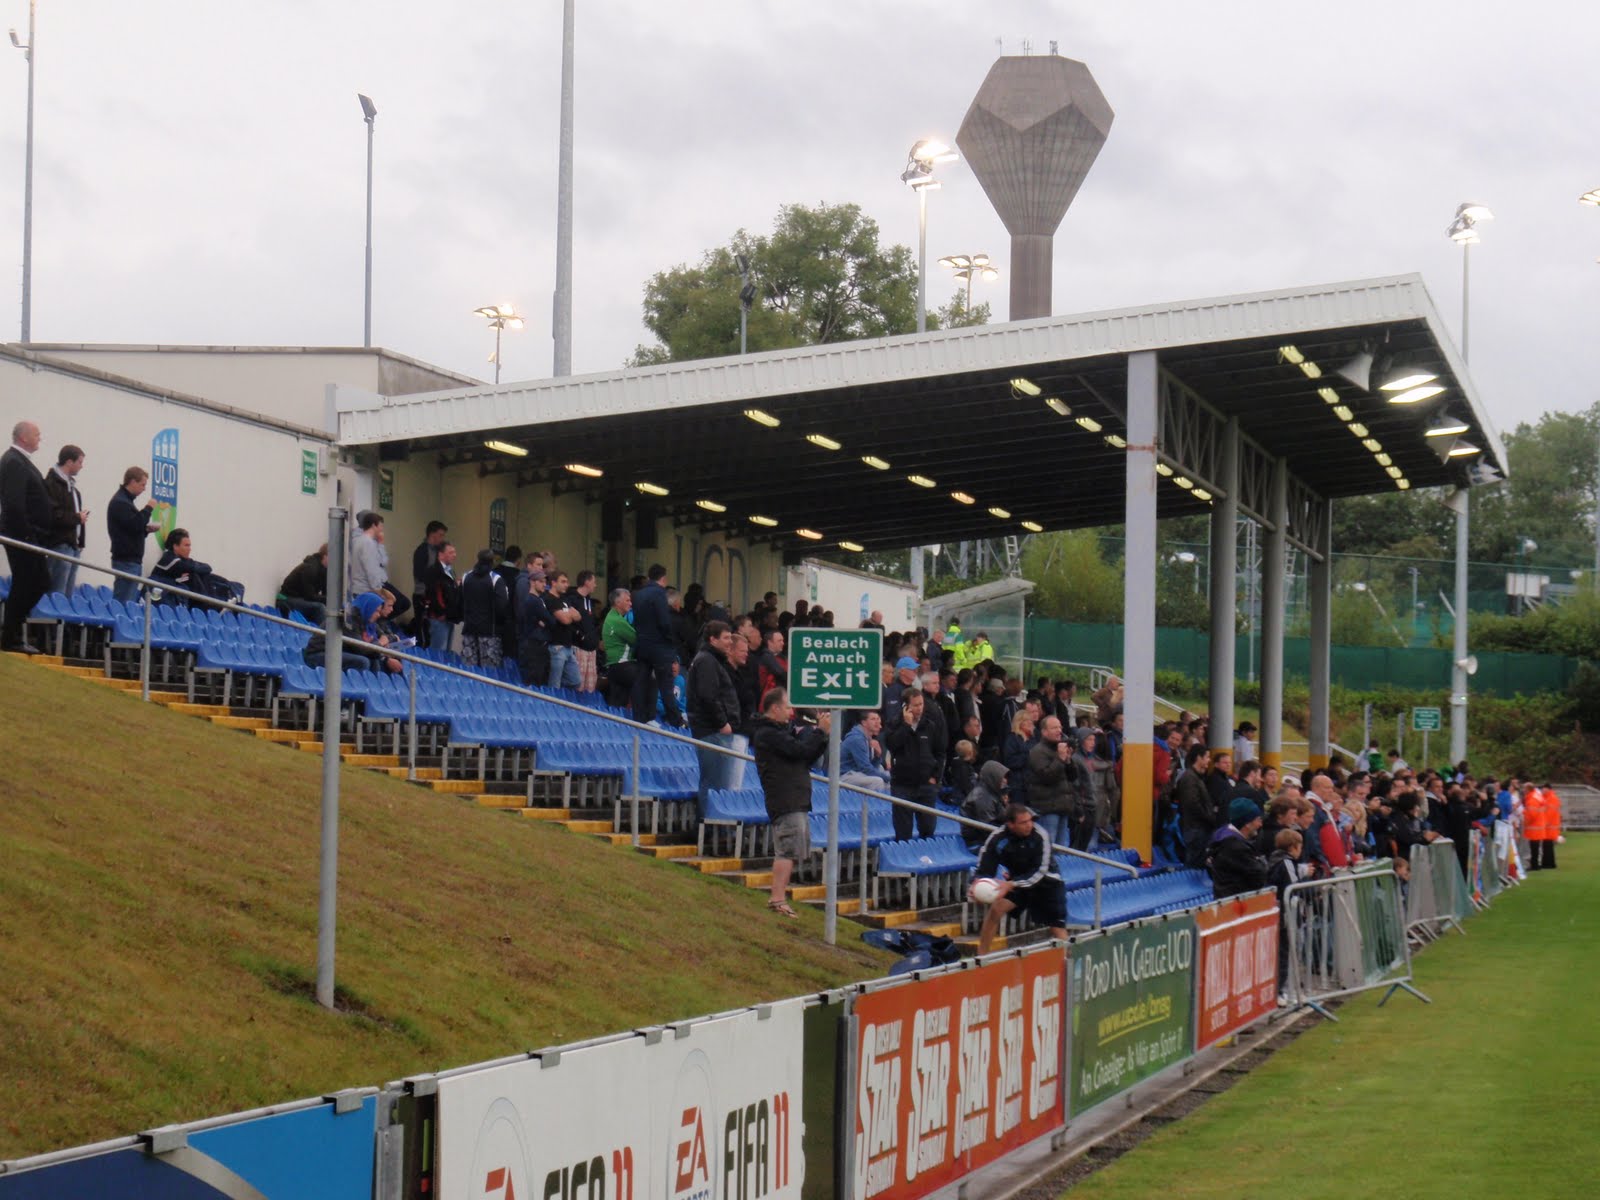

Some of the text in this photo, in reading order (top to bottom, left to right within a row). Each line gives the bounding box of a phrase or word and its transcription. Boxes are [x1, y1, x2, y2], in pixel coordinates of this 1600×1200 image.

[154, 461, 176, 486] UCD
[154, 485, 175, 499] DUBLIN
[802, 636, 869, 649] Bealach
[805, 651, 866, 664] Amach
[801, 667, 870, 689] Exit
[1168, 928, 1192, 973] UCD
[675, 1105, 709, 1194] EA
[723, 1098, 769, 1200] FIFA
[773, 1091, 789, 1191] 11
